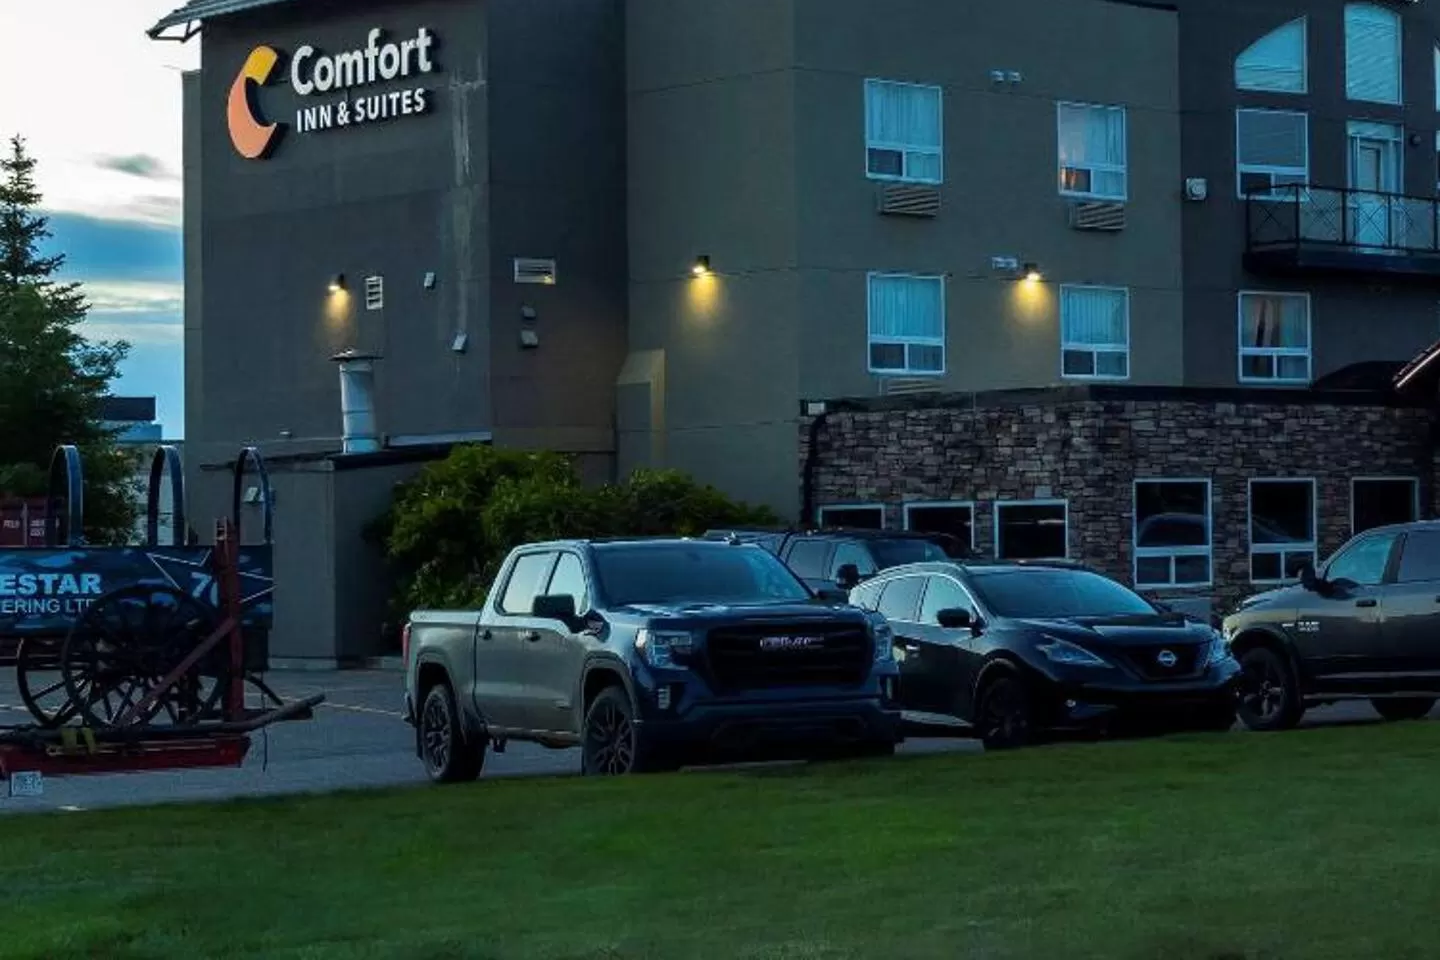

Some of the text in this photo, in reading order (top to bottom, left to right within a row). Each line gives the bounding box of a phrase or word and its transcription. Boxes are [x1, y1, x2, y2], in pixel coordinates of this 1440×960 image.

[291, 28, 432, 95] Comfort
[296, 88, 426, 134] INN & SUITES
[0, 573, 103, 596] ESTAR
[1, 598, 61, 614] ERING
